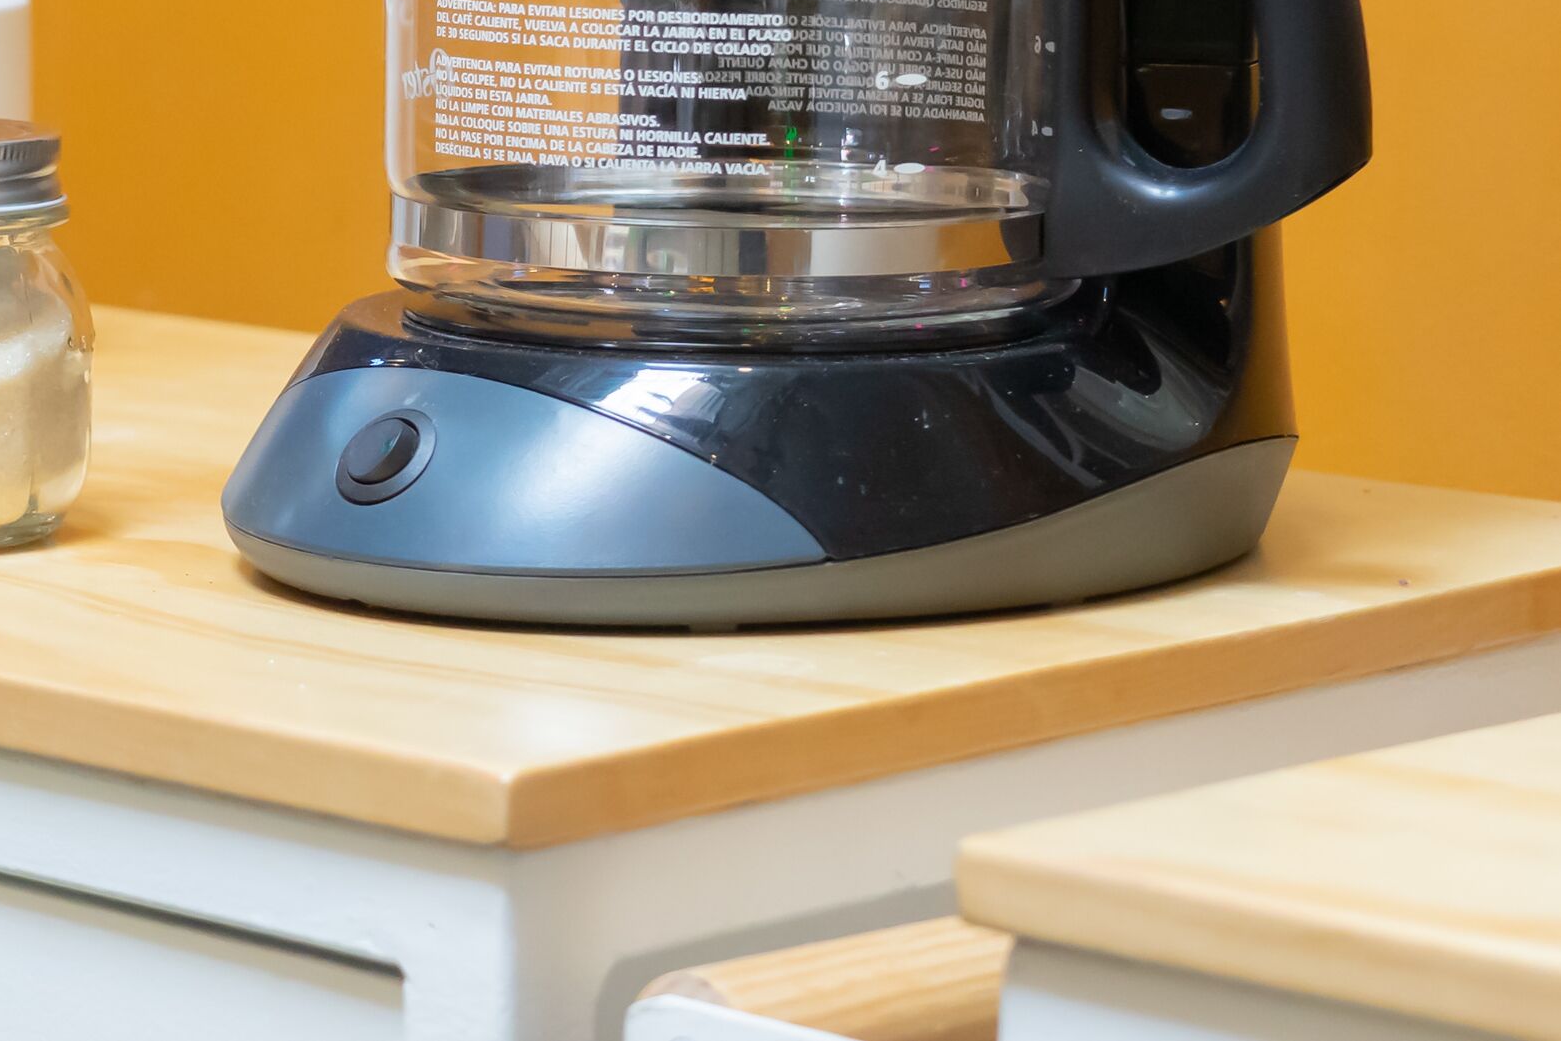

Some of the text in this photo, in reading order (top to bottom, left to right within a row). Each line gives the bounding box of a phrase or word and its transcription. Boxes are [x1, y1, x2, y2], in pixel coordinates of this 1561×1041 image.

[436, 11, 792, 42] DEL CAFÉ CALIENTE, VUELVA A COLOCAR LA JARRA EN EL PLAZO
[498, 2, 526, 15] PARA
[528, 4, 566, 18] EVITAR
[569, 7, 626, 21] LESIONES
[628, 10, 656, 22] POR
[658, 11, 784, 26] DESBORDAMIENTO
[436, 26, 775, 56] DE 30 SEGUNDOS SI LA SACA DURANTE EL CICLO DE COLADO.
[436, 69, 747, 100] NO LA GOLPEE, NO LA CALIENTE SI ESTÁ VACÍA NI HIERVA
[495, 61, 522, 74] PARA
[524, 63, 561, 77] EVITAR
[564, 66, 621, 81] ROTURAS
[623, 69, 635, 81] O
[876, 70, 888, 90] 6
[436, 83, 552, 106] LÍQUIDOS EN ESTA JARRA.
[436, 98, 660, 128] NO LA LIMPIE CON MATERIALES ABRASIVOS.
[436, 128, 701, 158] NO LA PASE POR ENCIMA DE LA CABEZA DE NADIE.
[449, 115, 459, 126] LA
[460, 116, 505, 133] COLOQUE
[508, 120, 541, 134] SOBRE
[544, 124, 569, 137] UNA
[572, 126, 617, 140] ESTUFA
[620, 129, 633, 141] NI
[638, 130, 701, 144] HORNILLA
[704, 132, 770, 145] CALIENTE.
[435, 140, 480, 158] DESÉCHELA
[483, 147, 491, 159] SI
[494, 148, 505, 161] SE
[507, 150, 537, 166] RAJA,
[539, 153, 569, 167] RAYA
[571, 156, 582, 168] O
[584, 157, 595, 169] SI
[682, 162, 722, 175] JARRA
[724, 162, 769, 175] VACÍA.
[873, 160, 887, 177] 4
